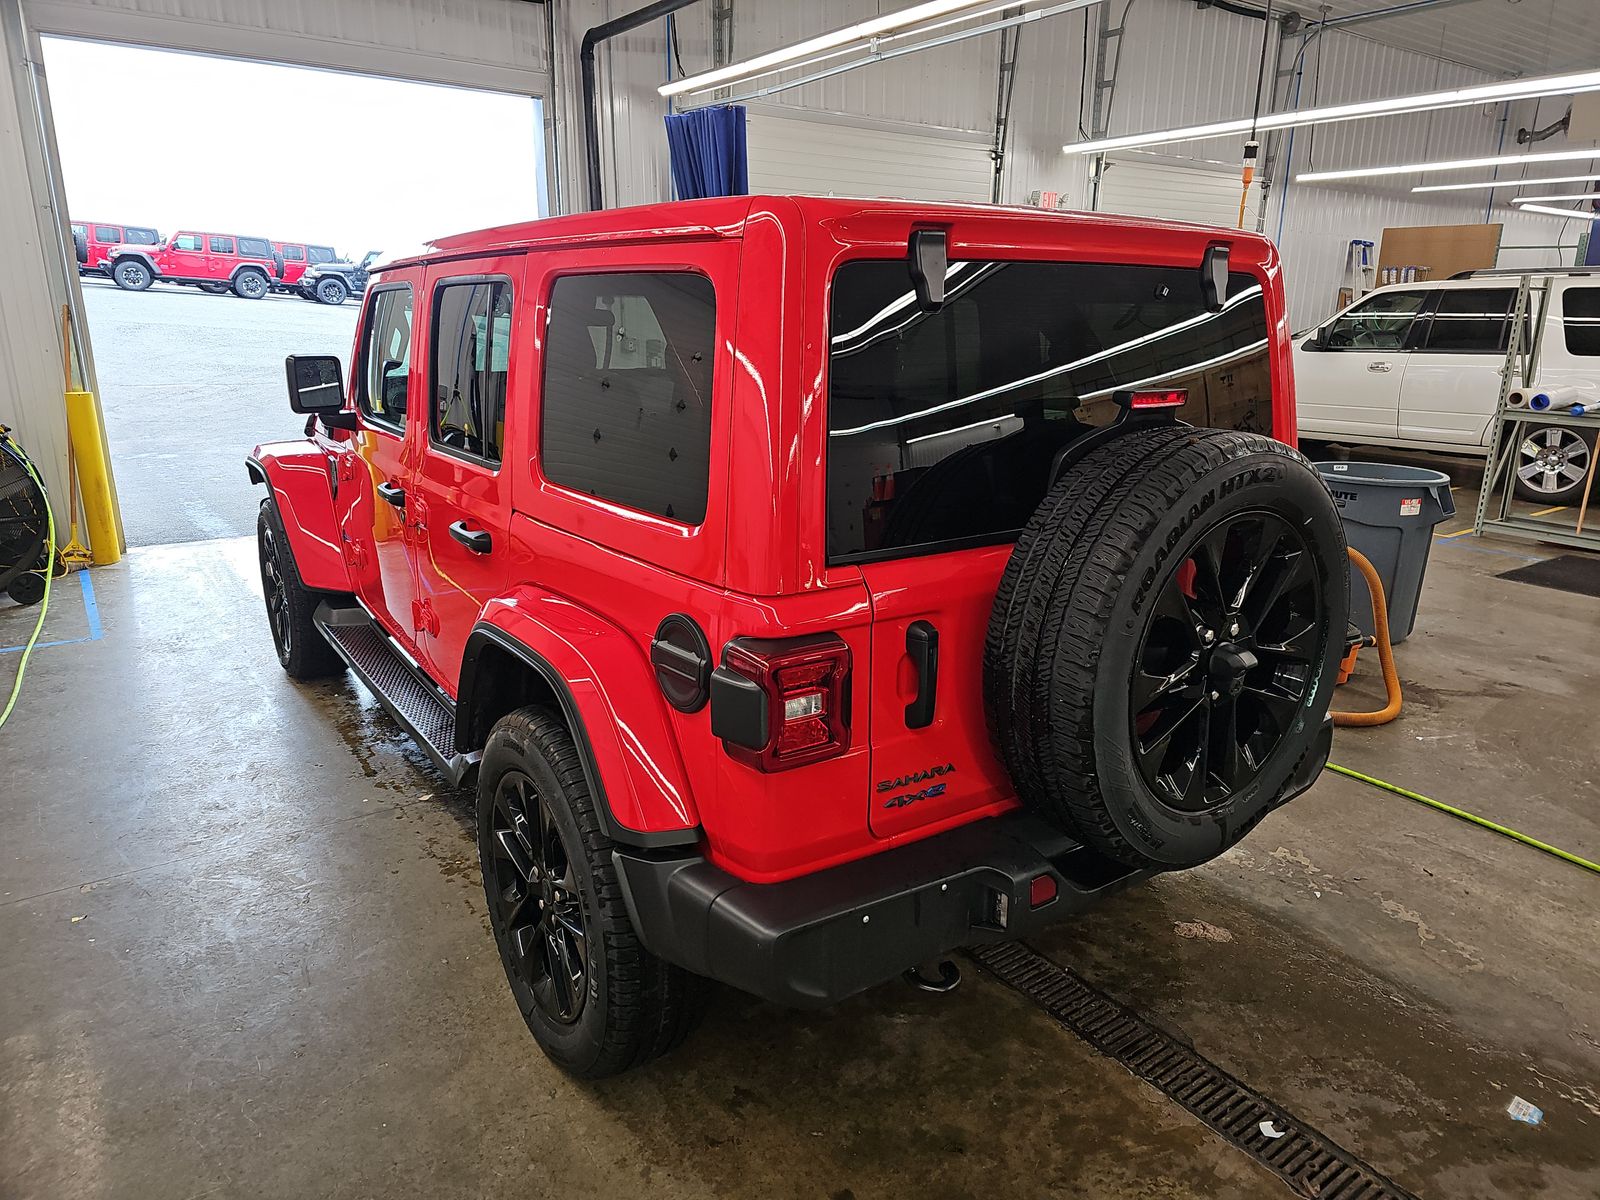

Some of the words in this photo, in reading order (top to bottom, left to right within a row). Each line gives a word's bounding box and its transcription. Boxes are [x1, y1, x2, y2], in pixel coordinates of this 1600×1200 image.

[1042, 192, 1057, 208] EXIT
[1331, 490, 1358, 501] UTE
[876, 762, 956, 793] SAHARA
